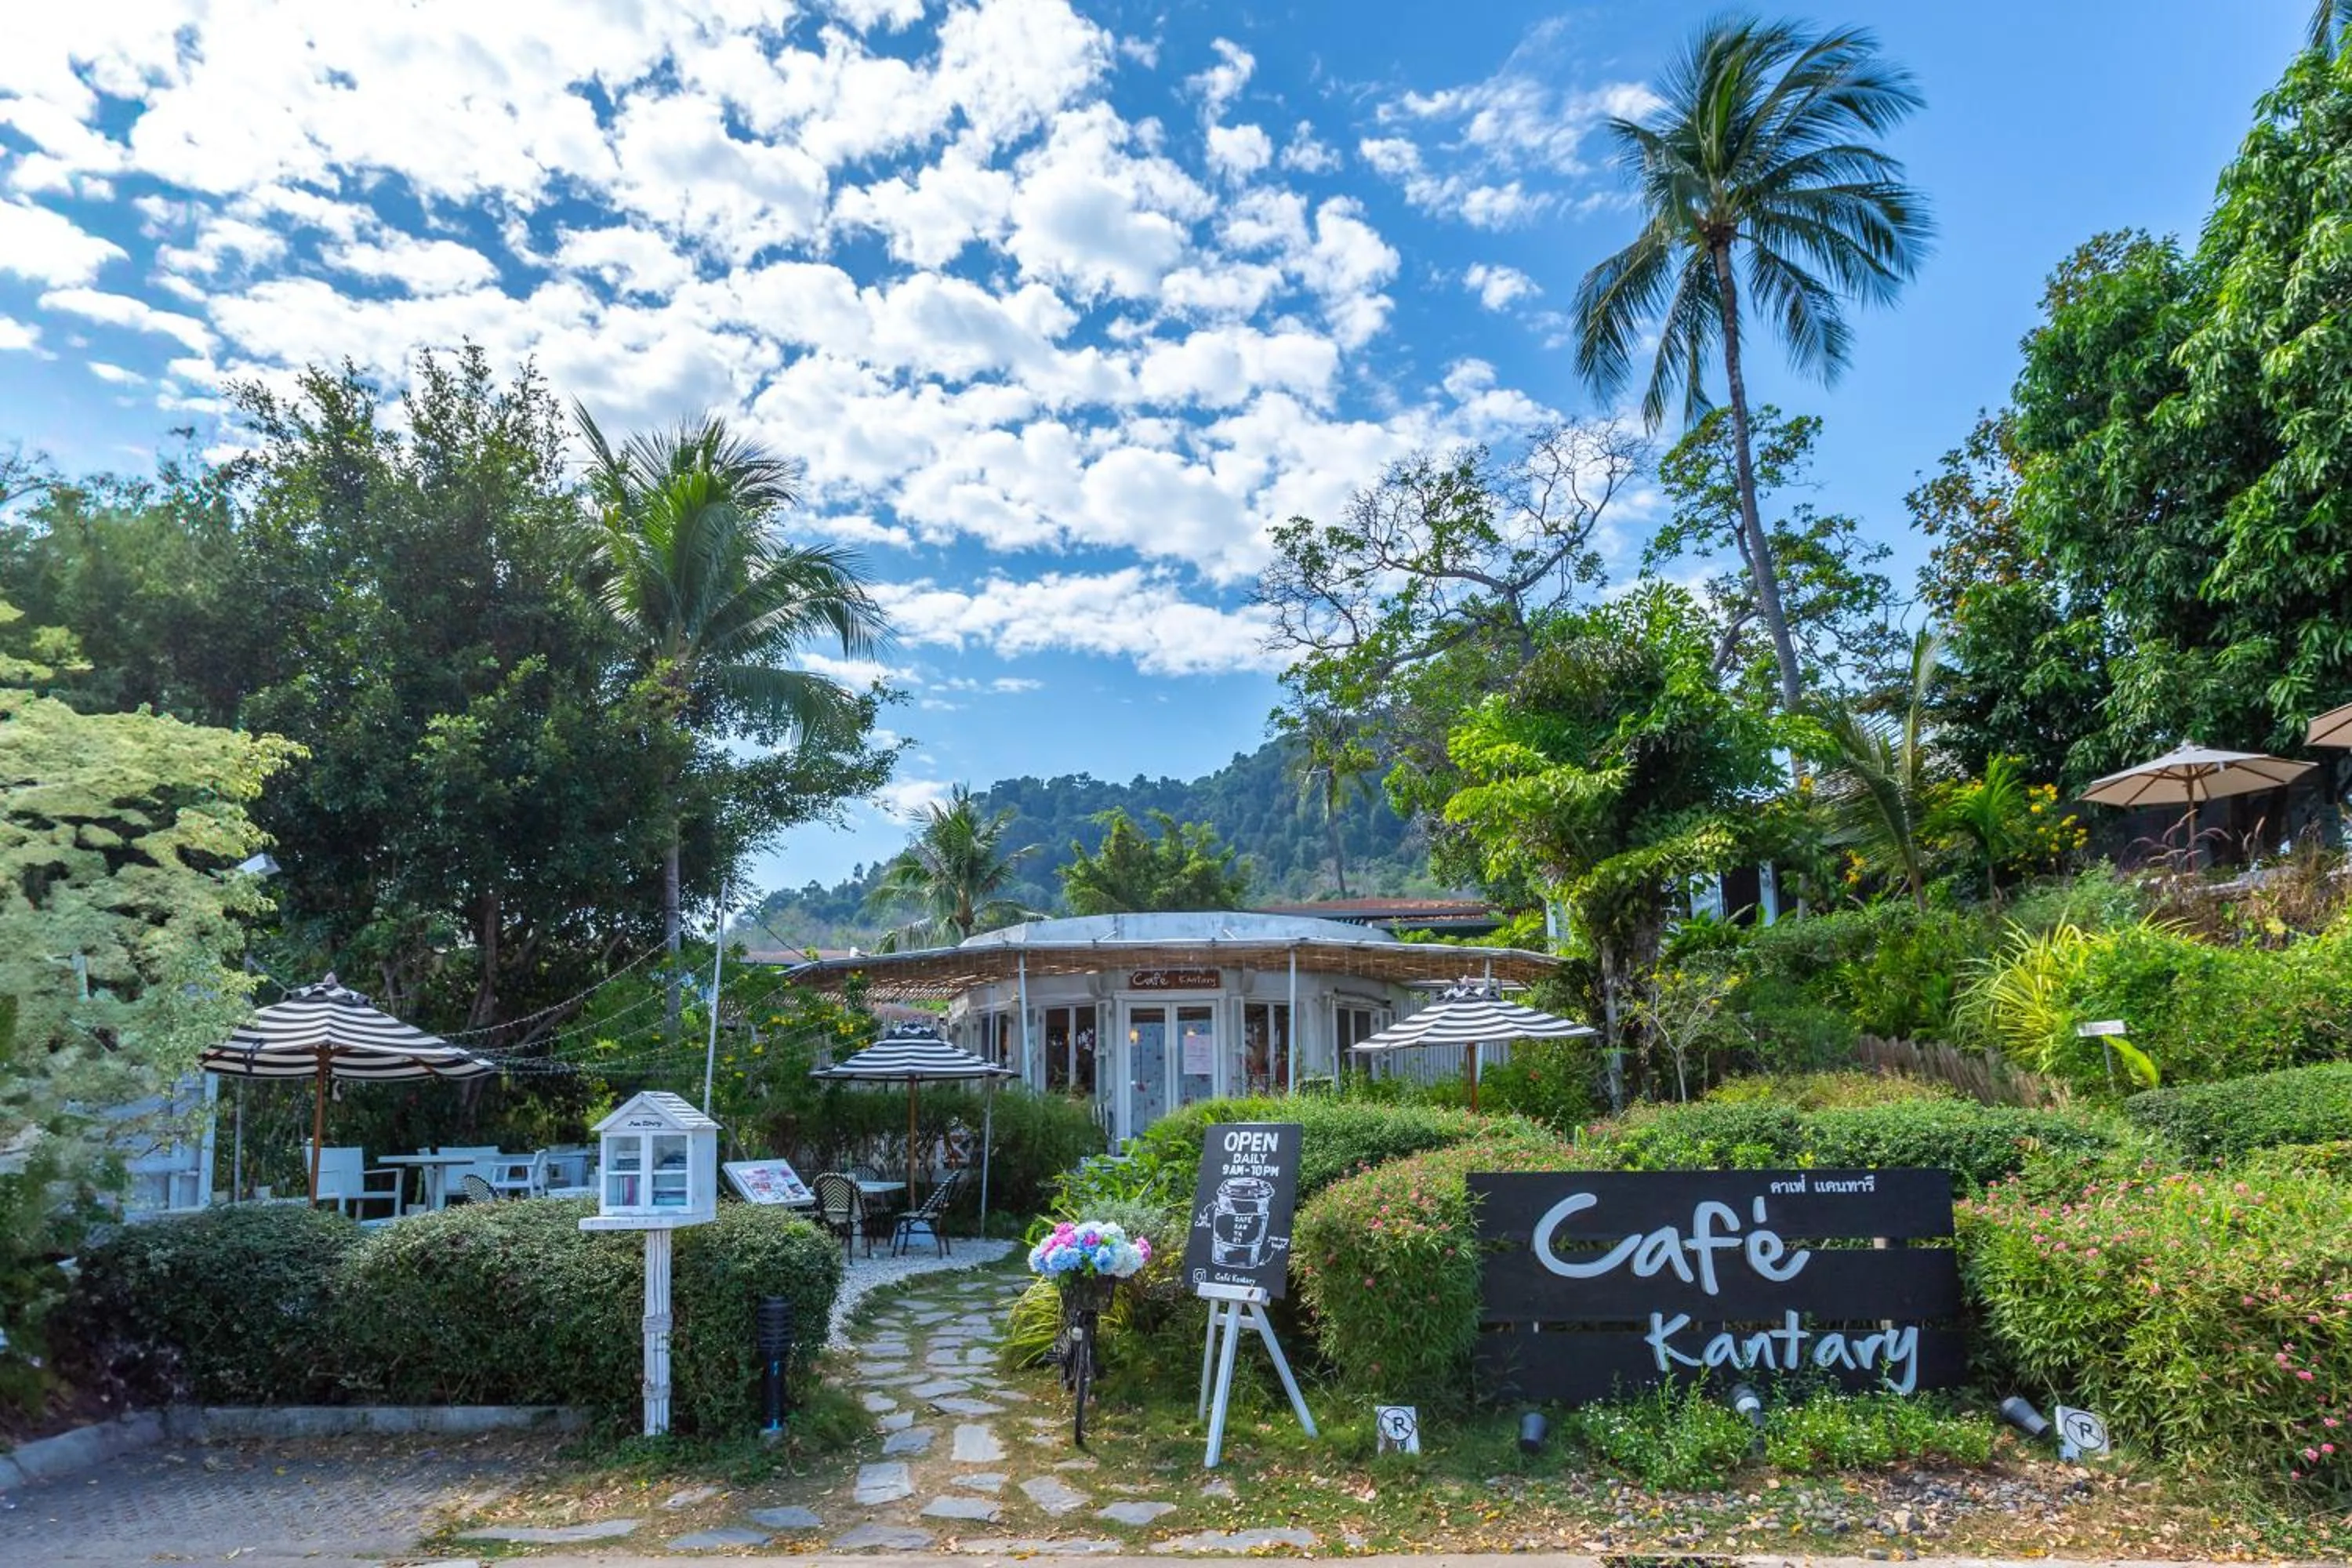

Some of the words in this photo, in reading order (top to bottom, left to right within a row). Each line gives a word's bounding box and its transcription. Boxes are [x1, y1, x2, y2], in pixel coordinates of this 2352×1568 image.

[1224, 1131, 1279, 1152] OPEN
[1233, 1153, 1268, 1165] DAILY
[1770, 1174, 1806, 1194] คาเฟ่
[1532, 1192, 1810, 1296] Café
[1645, 1310, 1918, 1395] Kantary
